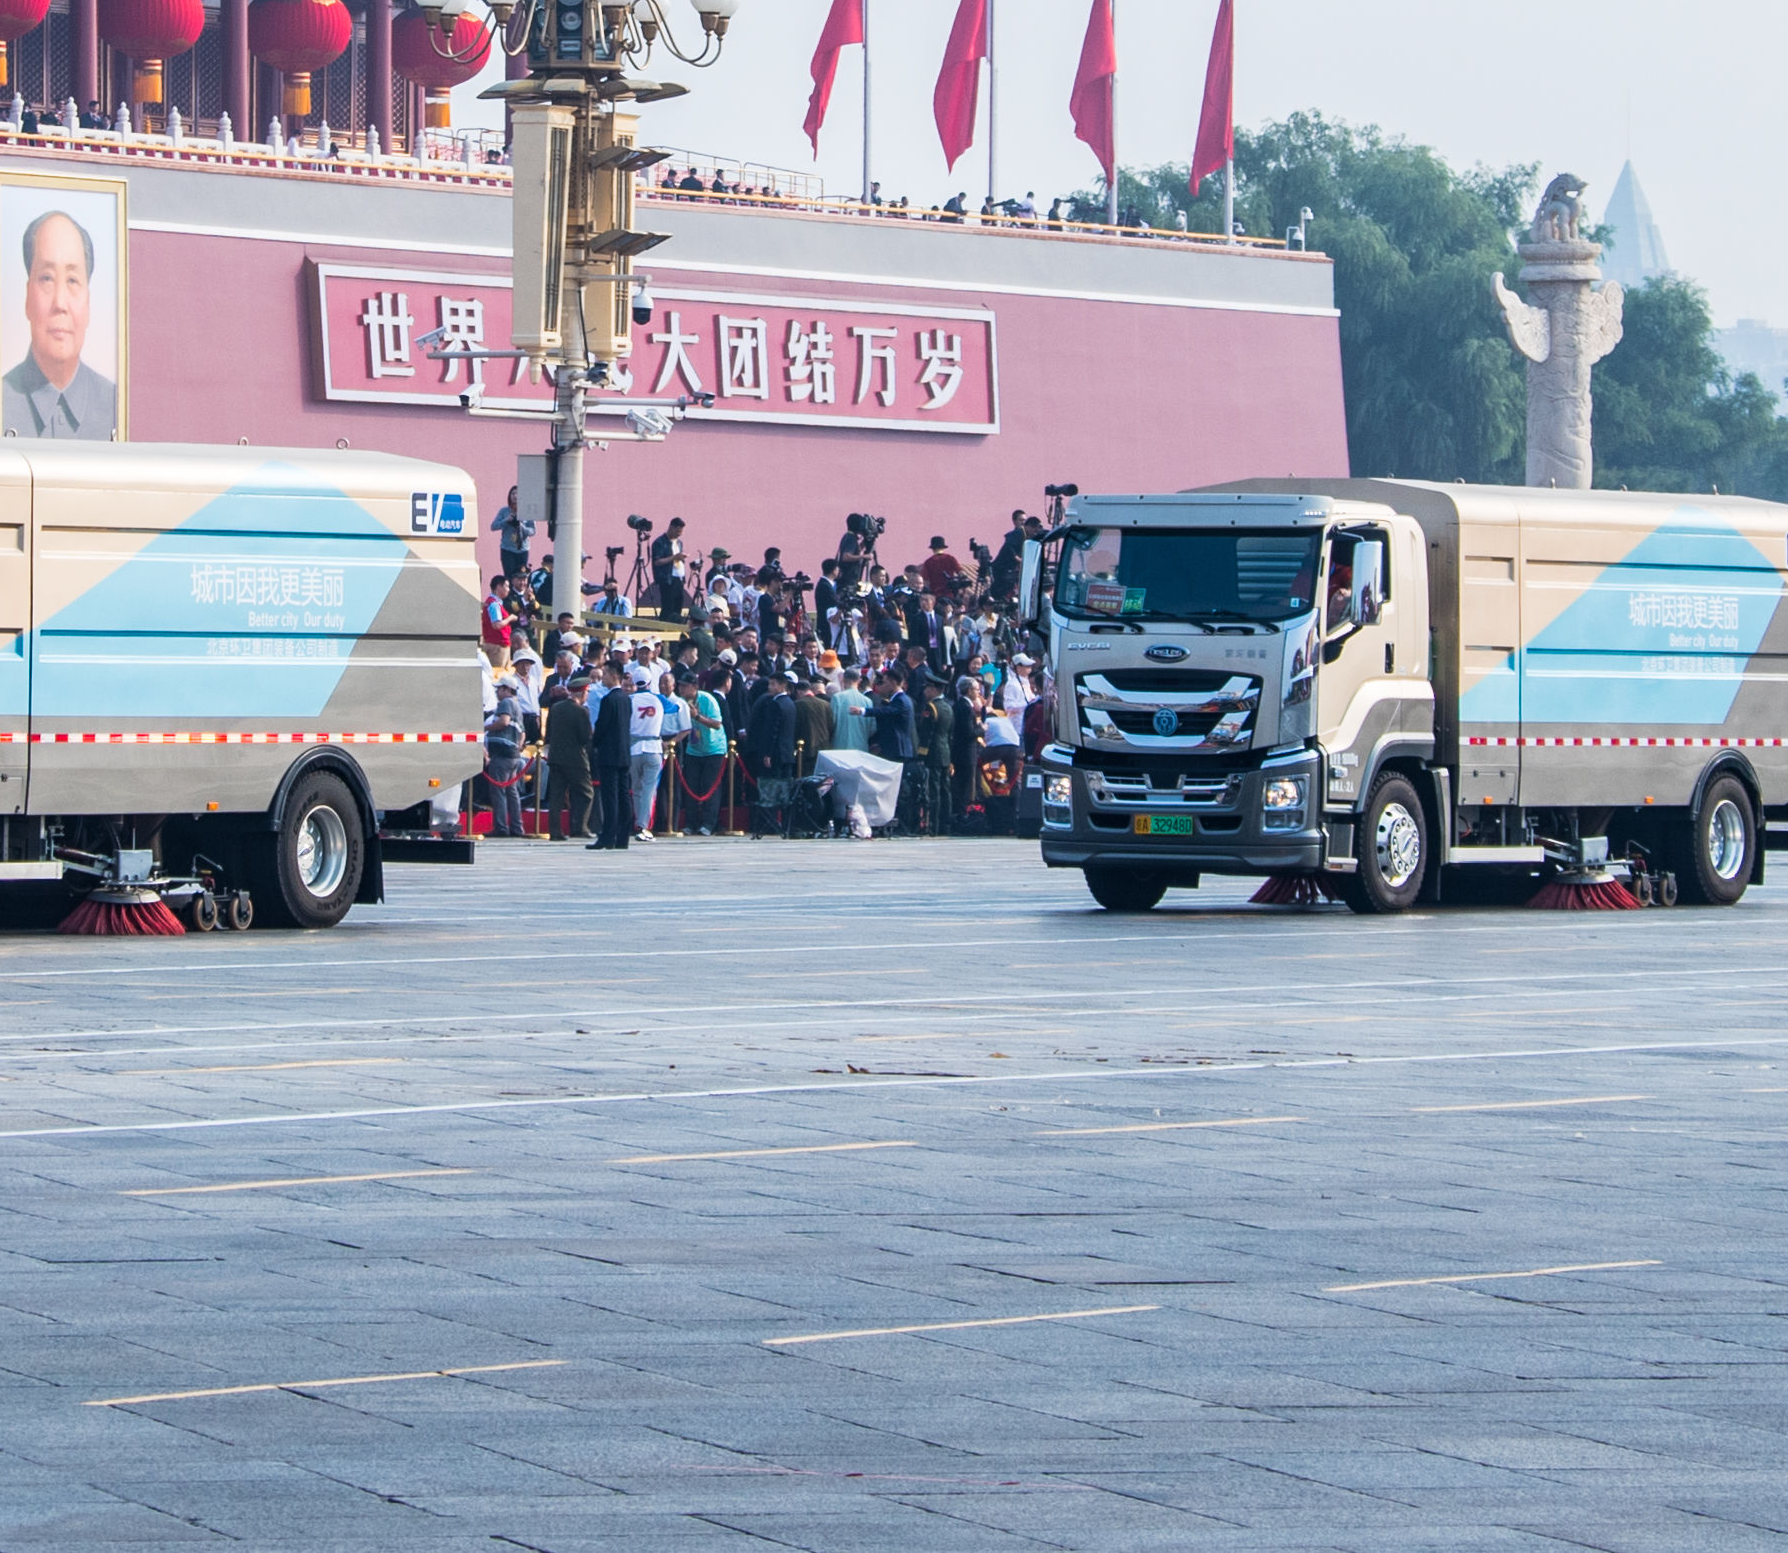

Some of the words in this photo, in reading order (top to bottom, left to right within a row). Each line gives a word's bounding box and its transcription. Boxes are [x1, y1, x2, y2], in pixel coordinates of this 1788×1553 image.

[361, 291, 964, 410] 世界大团结万岁
[190, 563, 345, 607] 城市因我更美丽
[248, 611, 280, 627] Better
[281, 611, 299, 630] city
[304, 611, 321, 627] Our
[324, 612, 345, 631] duty
[1629, 592, 1739, 630] 城市因我更美丽
